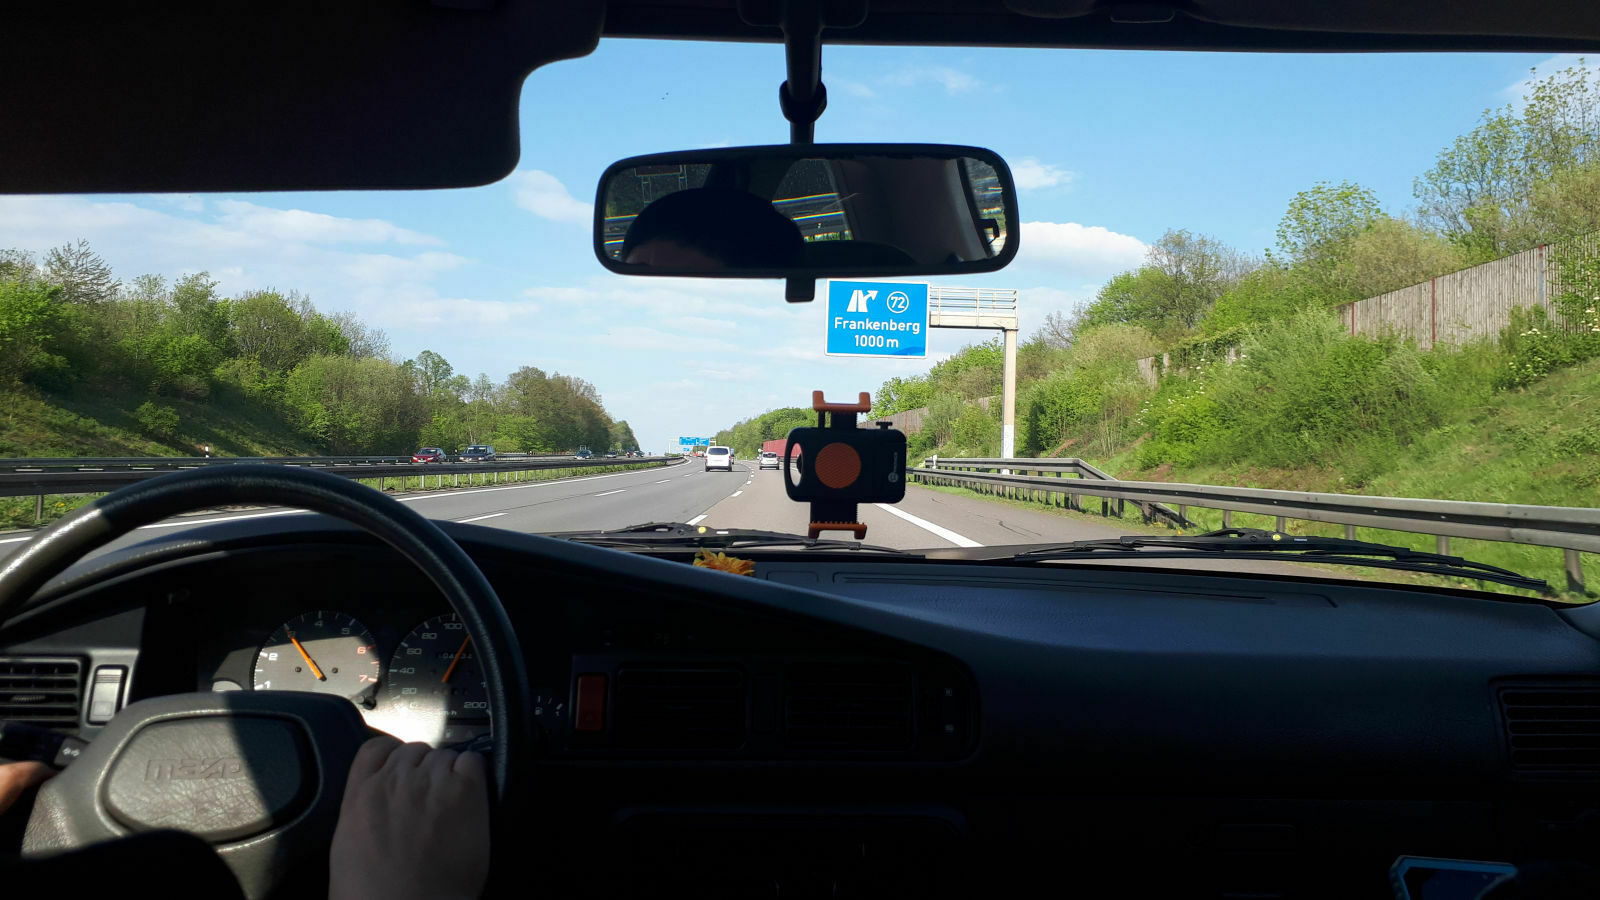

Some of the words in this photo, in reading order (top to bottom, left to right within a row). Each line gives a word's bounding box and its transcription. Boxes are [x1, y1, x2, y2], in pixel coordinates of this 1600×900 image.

[890, 296, 905, 309] 72
[834, 317, 920, 334] Frankenberg
[855, 335, 884, 348] 1000
[886, 339, 899, 348] m
[341, 627, 351, 635] 5
[357, 646, 366, 655] 6
[268, 652, 278, 661] 2
[359, 674, 368, 682] 7
[264, 681, 271, 689] 1
[402, 687, 417, 695] 20
[463, 701, 487, 709] 200
